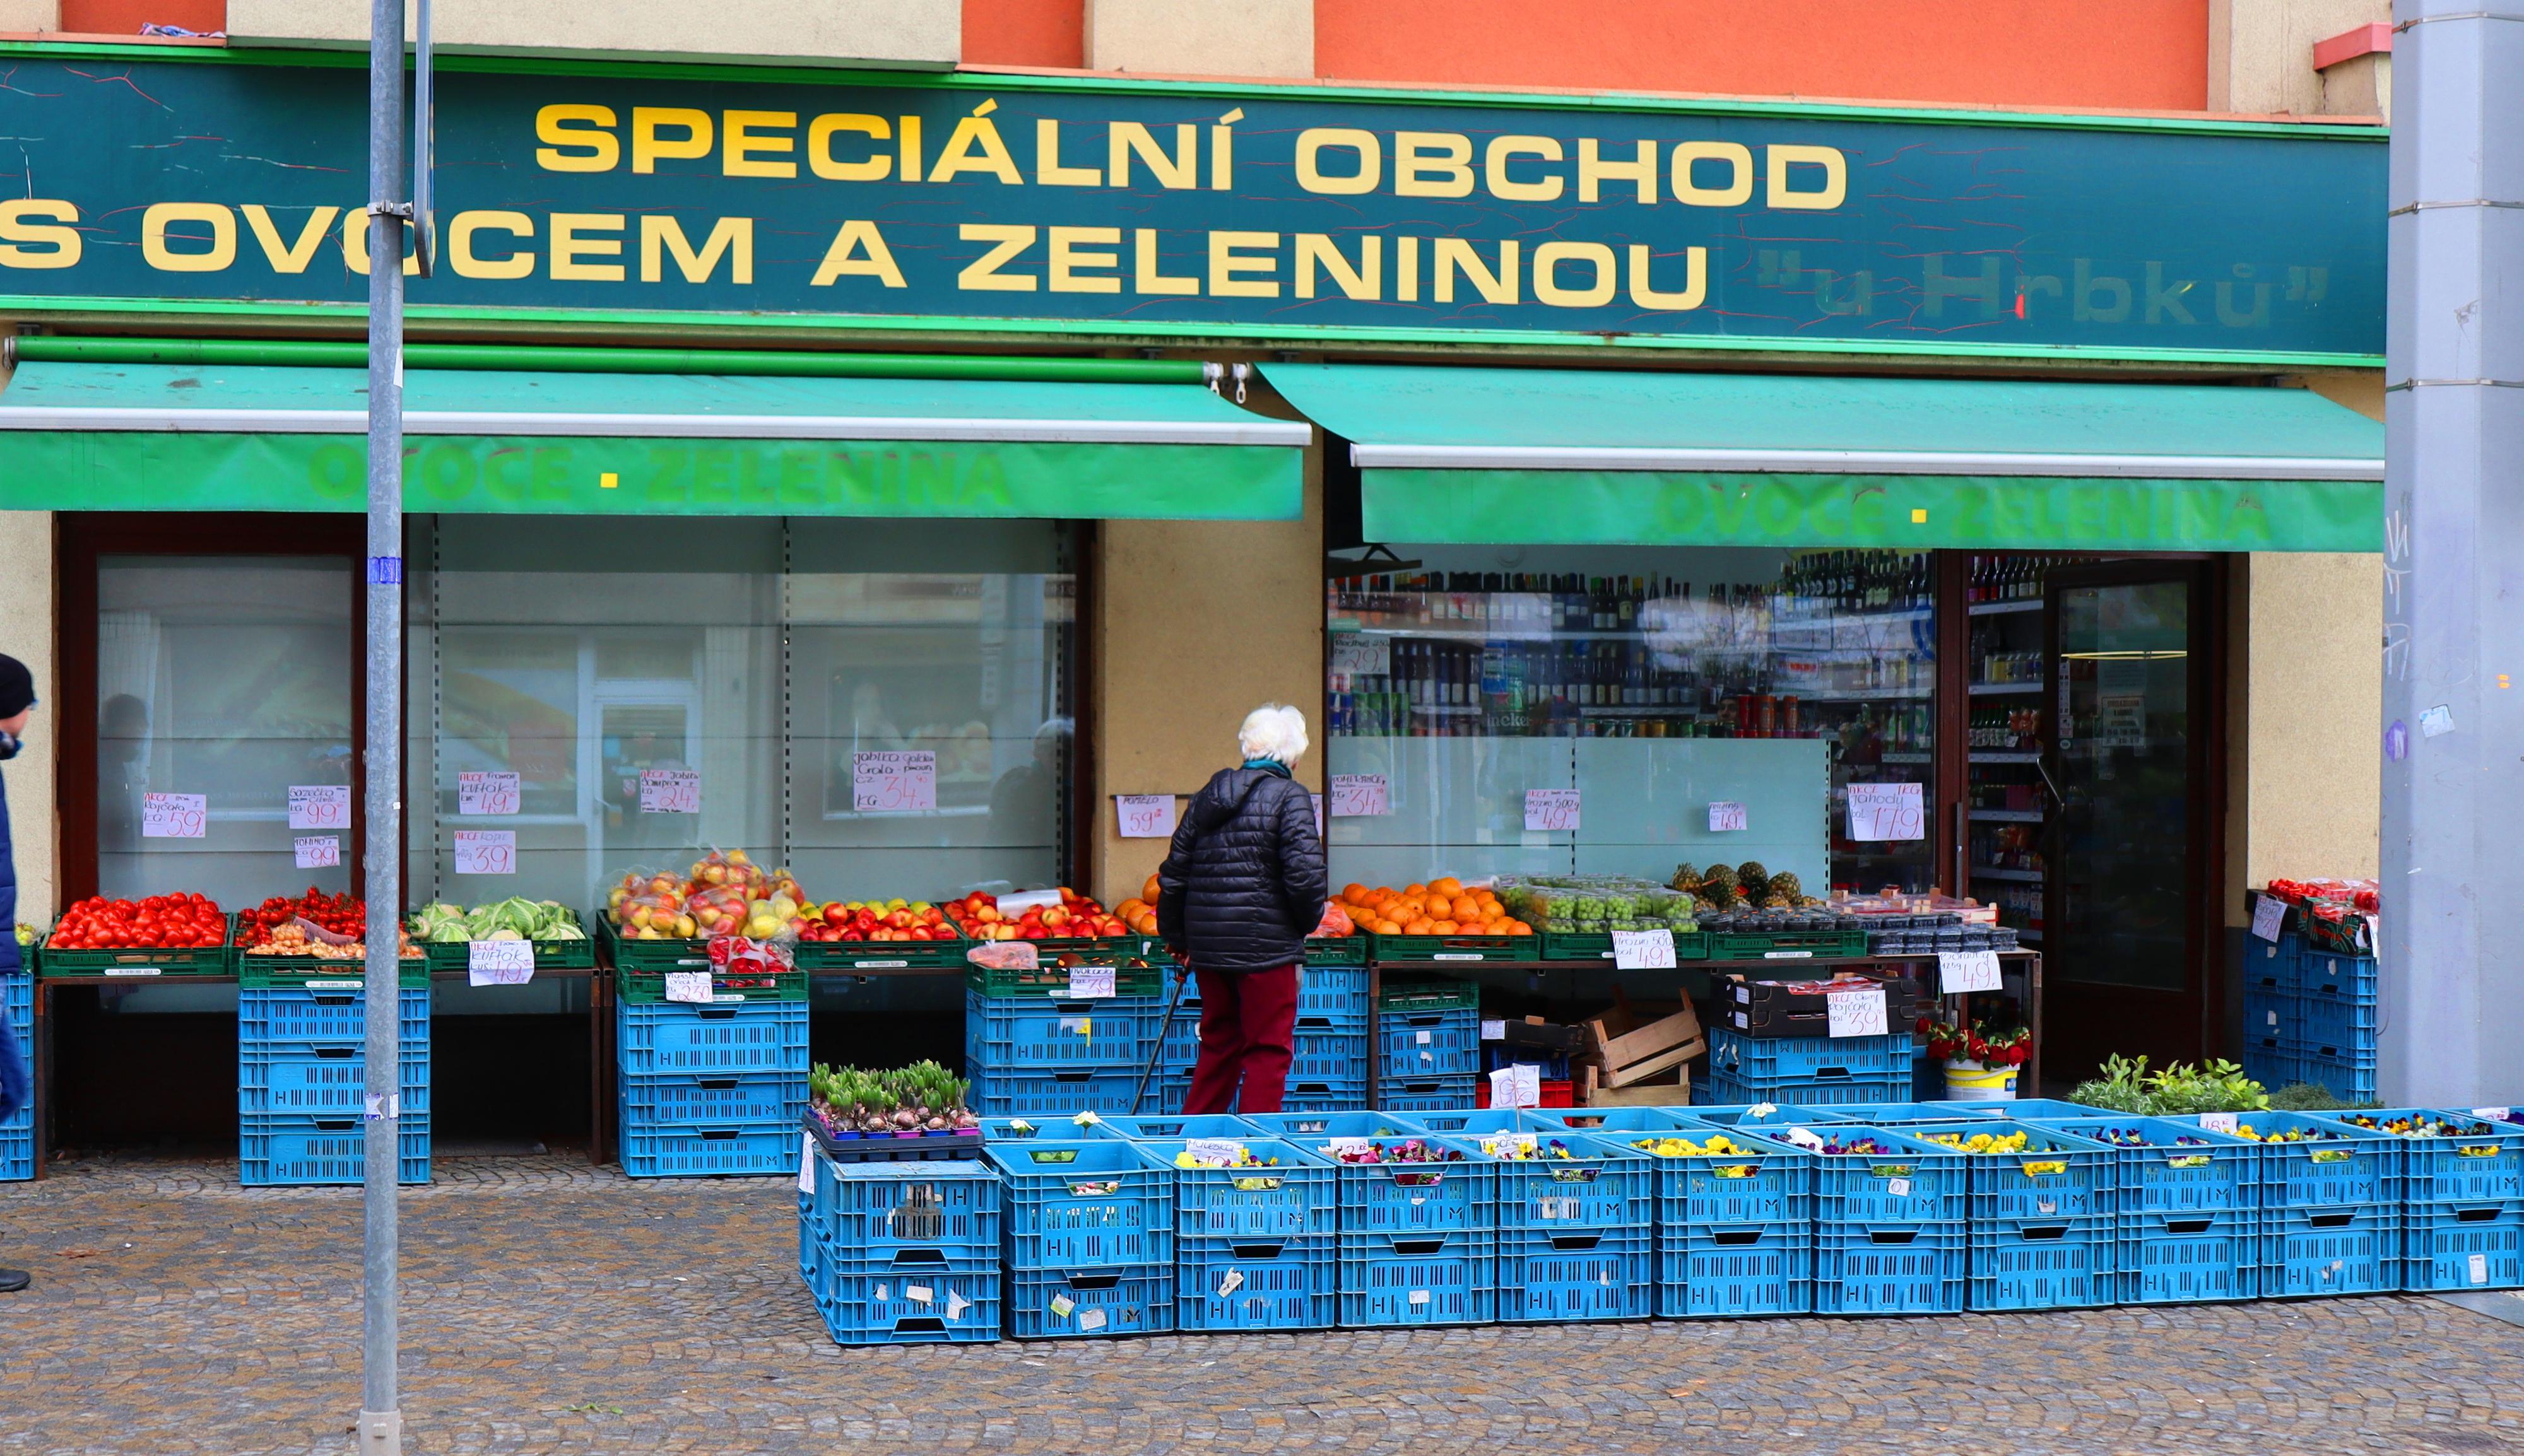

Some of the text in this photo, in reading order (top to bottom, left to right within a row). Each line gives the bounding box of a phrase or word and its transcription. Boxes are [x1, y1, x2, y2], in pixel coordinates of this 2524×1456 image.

[535, 98, 1846, 209] SPECIÁLNÍ OBCHOD
[0, 199, 82, 269] S
[810, 221, 907, 288] A
[958, 224, 1707, 310] ZELENINOU
[645, 447, 1011, 506] ZELENINA
[1654, 480, 2270, 541] OVOCE ZELENINA
